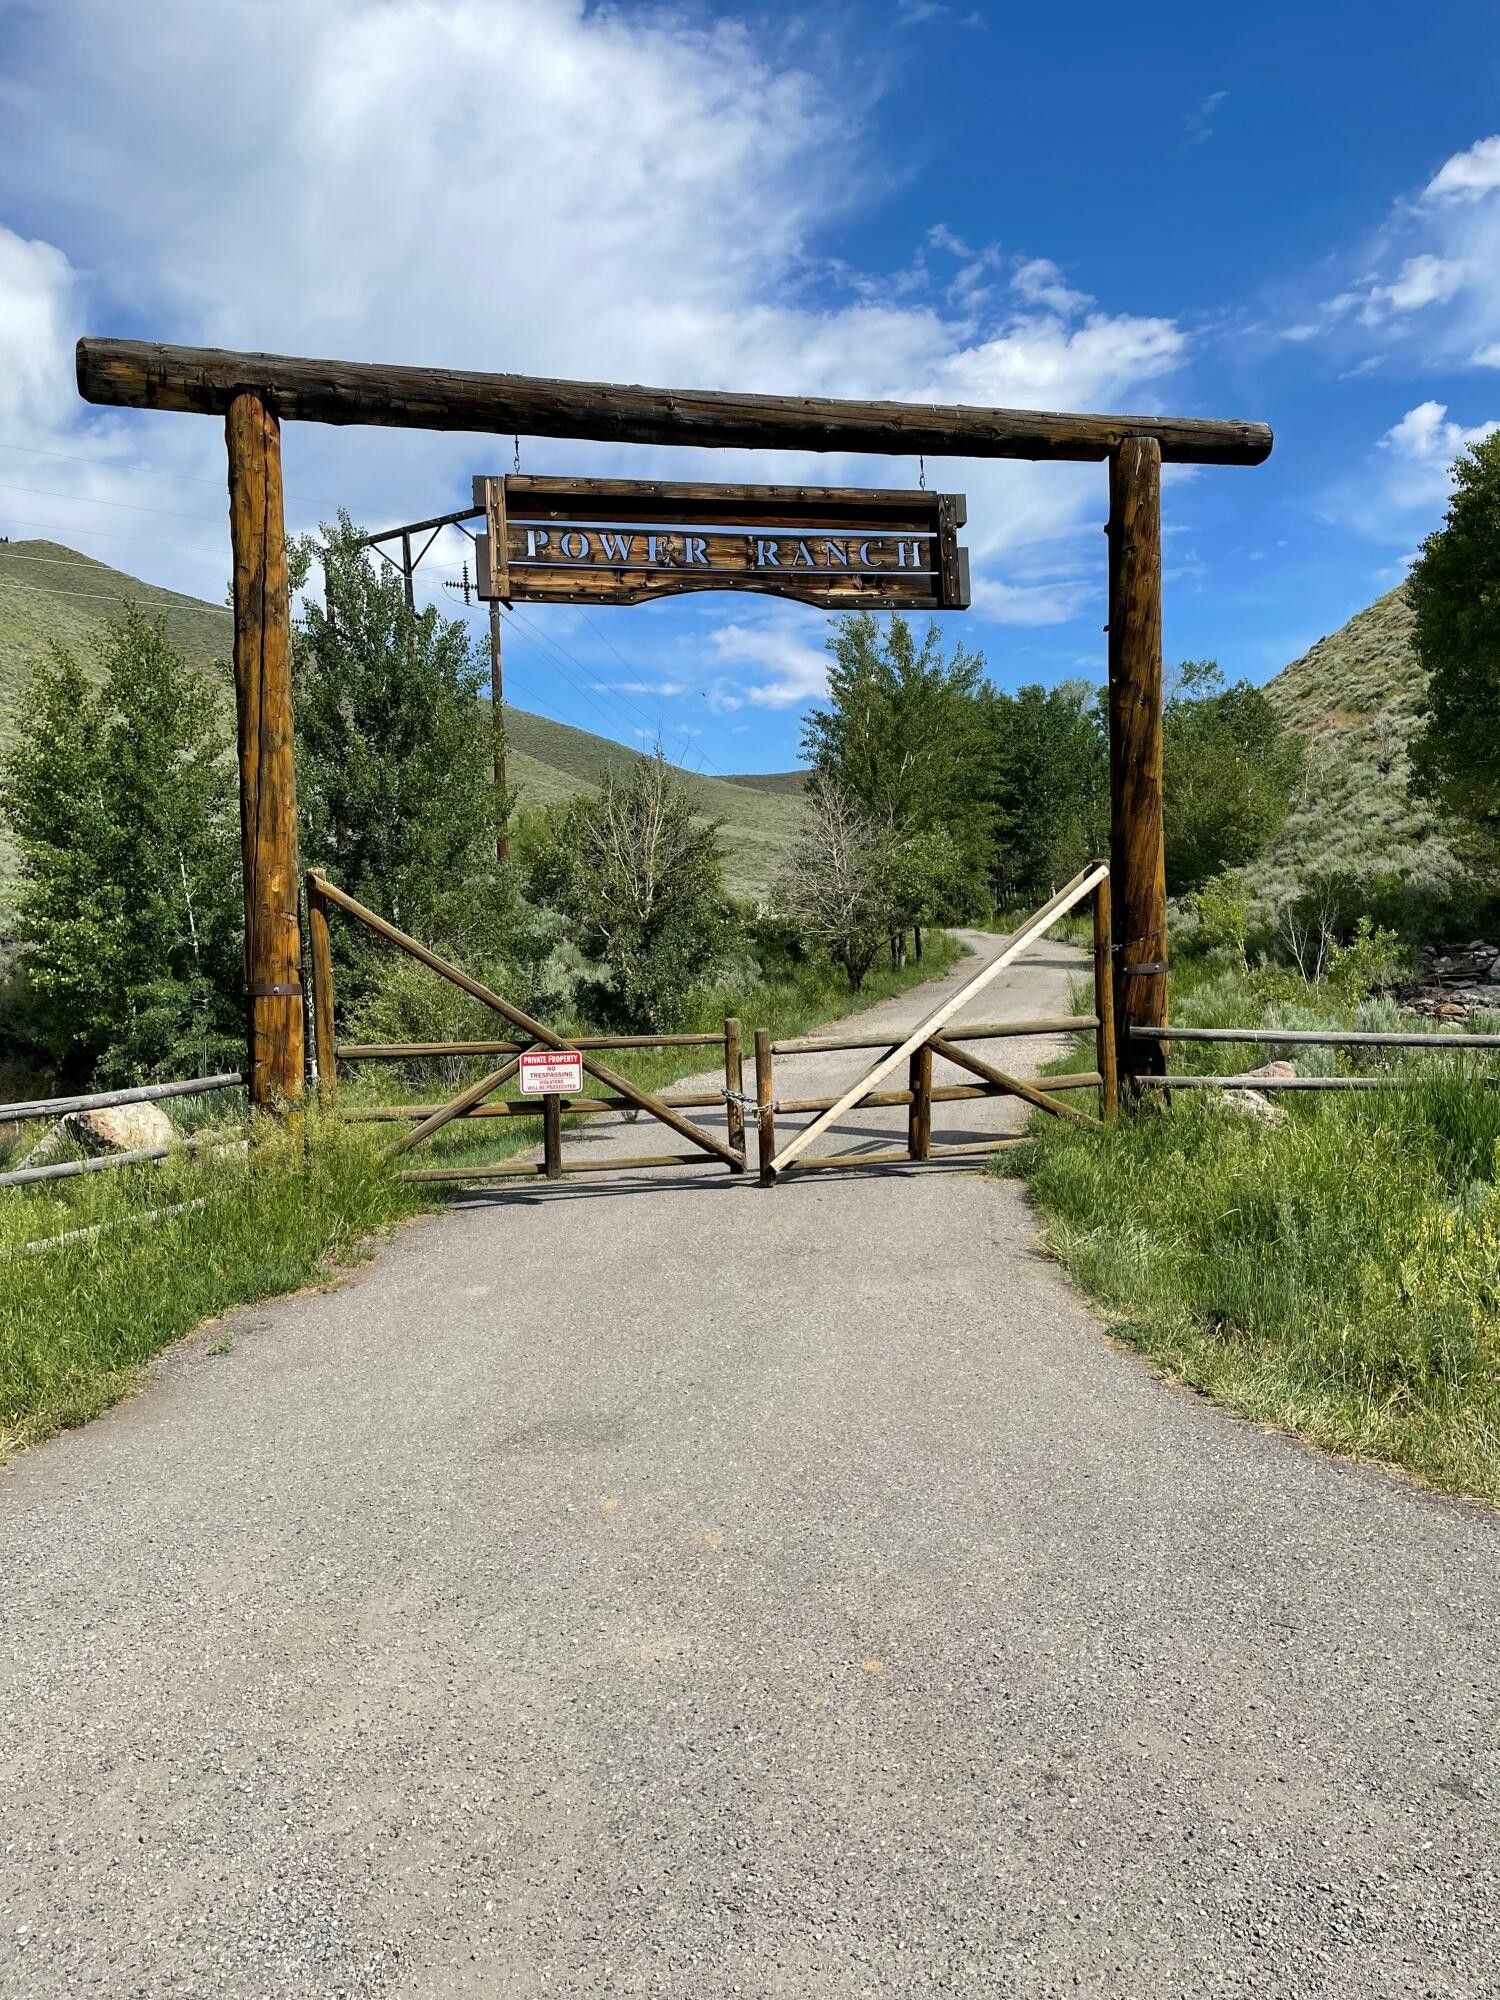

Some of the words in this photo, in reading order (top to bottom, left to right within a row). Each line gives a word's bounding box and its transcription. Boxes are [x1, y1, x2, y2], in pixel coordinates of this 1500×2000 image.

[526, 529, 709, 564] POWER
[756, 539, 922, 567] RANCH
[523, 1055, 547, 1064] PRIVATE
[548, 1054, 578, 1063] PROPERTY
